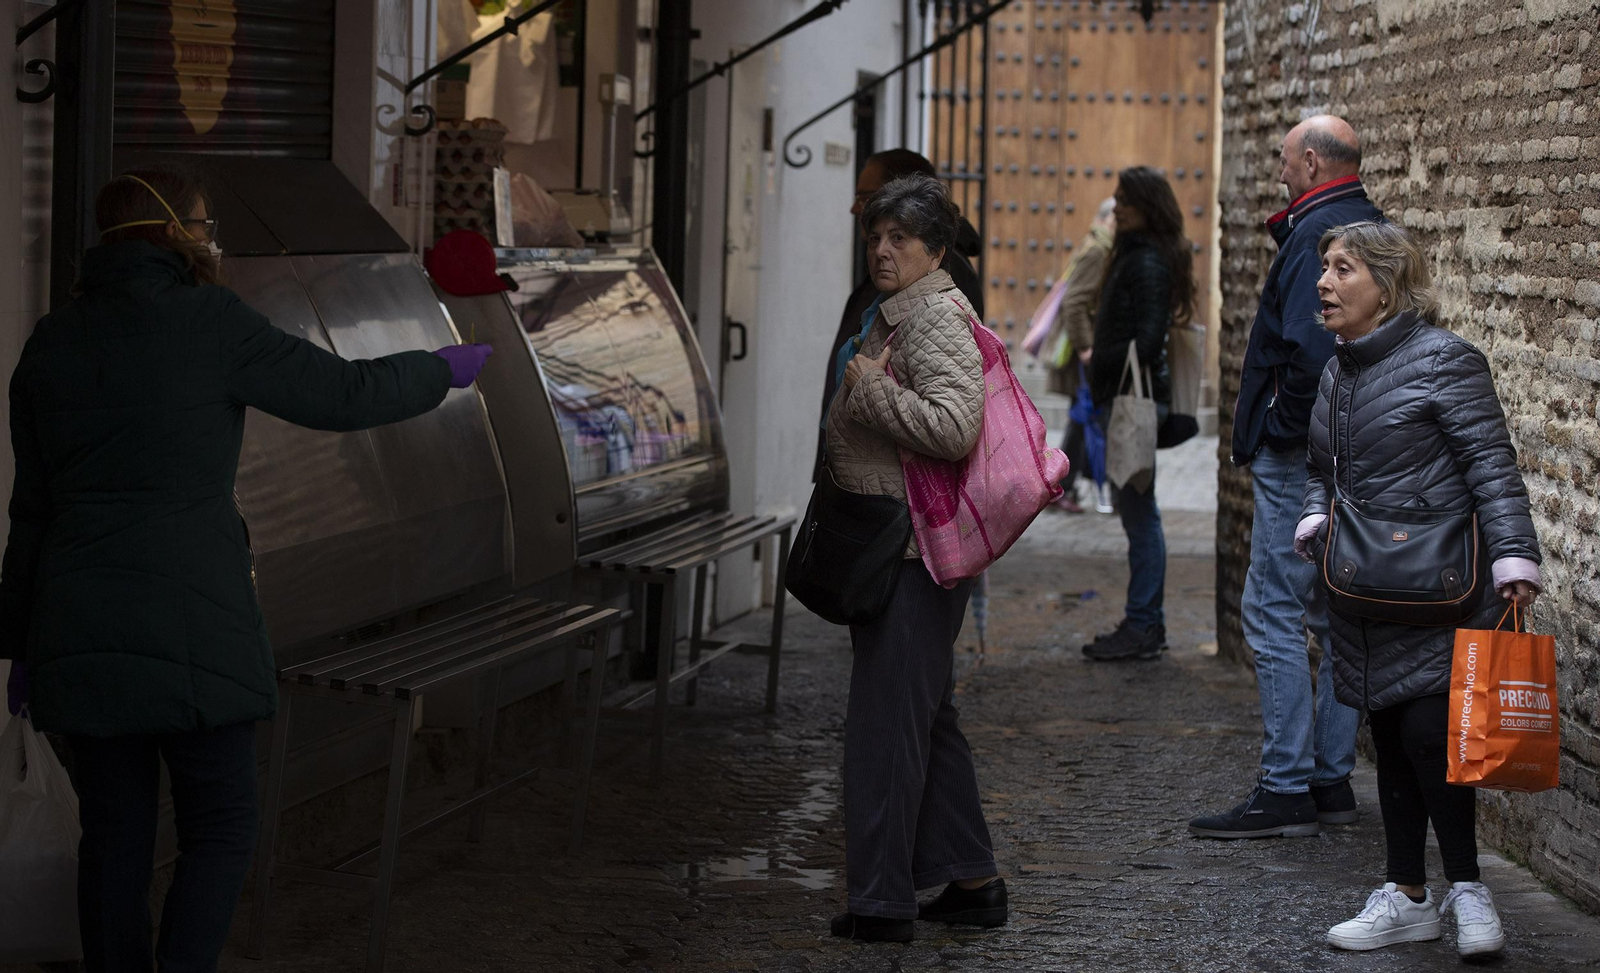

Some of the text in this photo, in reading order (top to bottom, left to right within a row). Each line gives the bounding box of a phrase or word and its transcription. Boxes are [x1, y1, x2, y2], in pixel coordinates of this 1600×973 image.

[1458, 643, 1478, 764] www.precchio.com
[1499, 690, 1551, 710] PRECCHIO
[1500, 718, 1530, 728] COLORS
